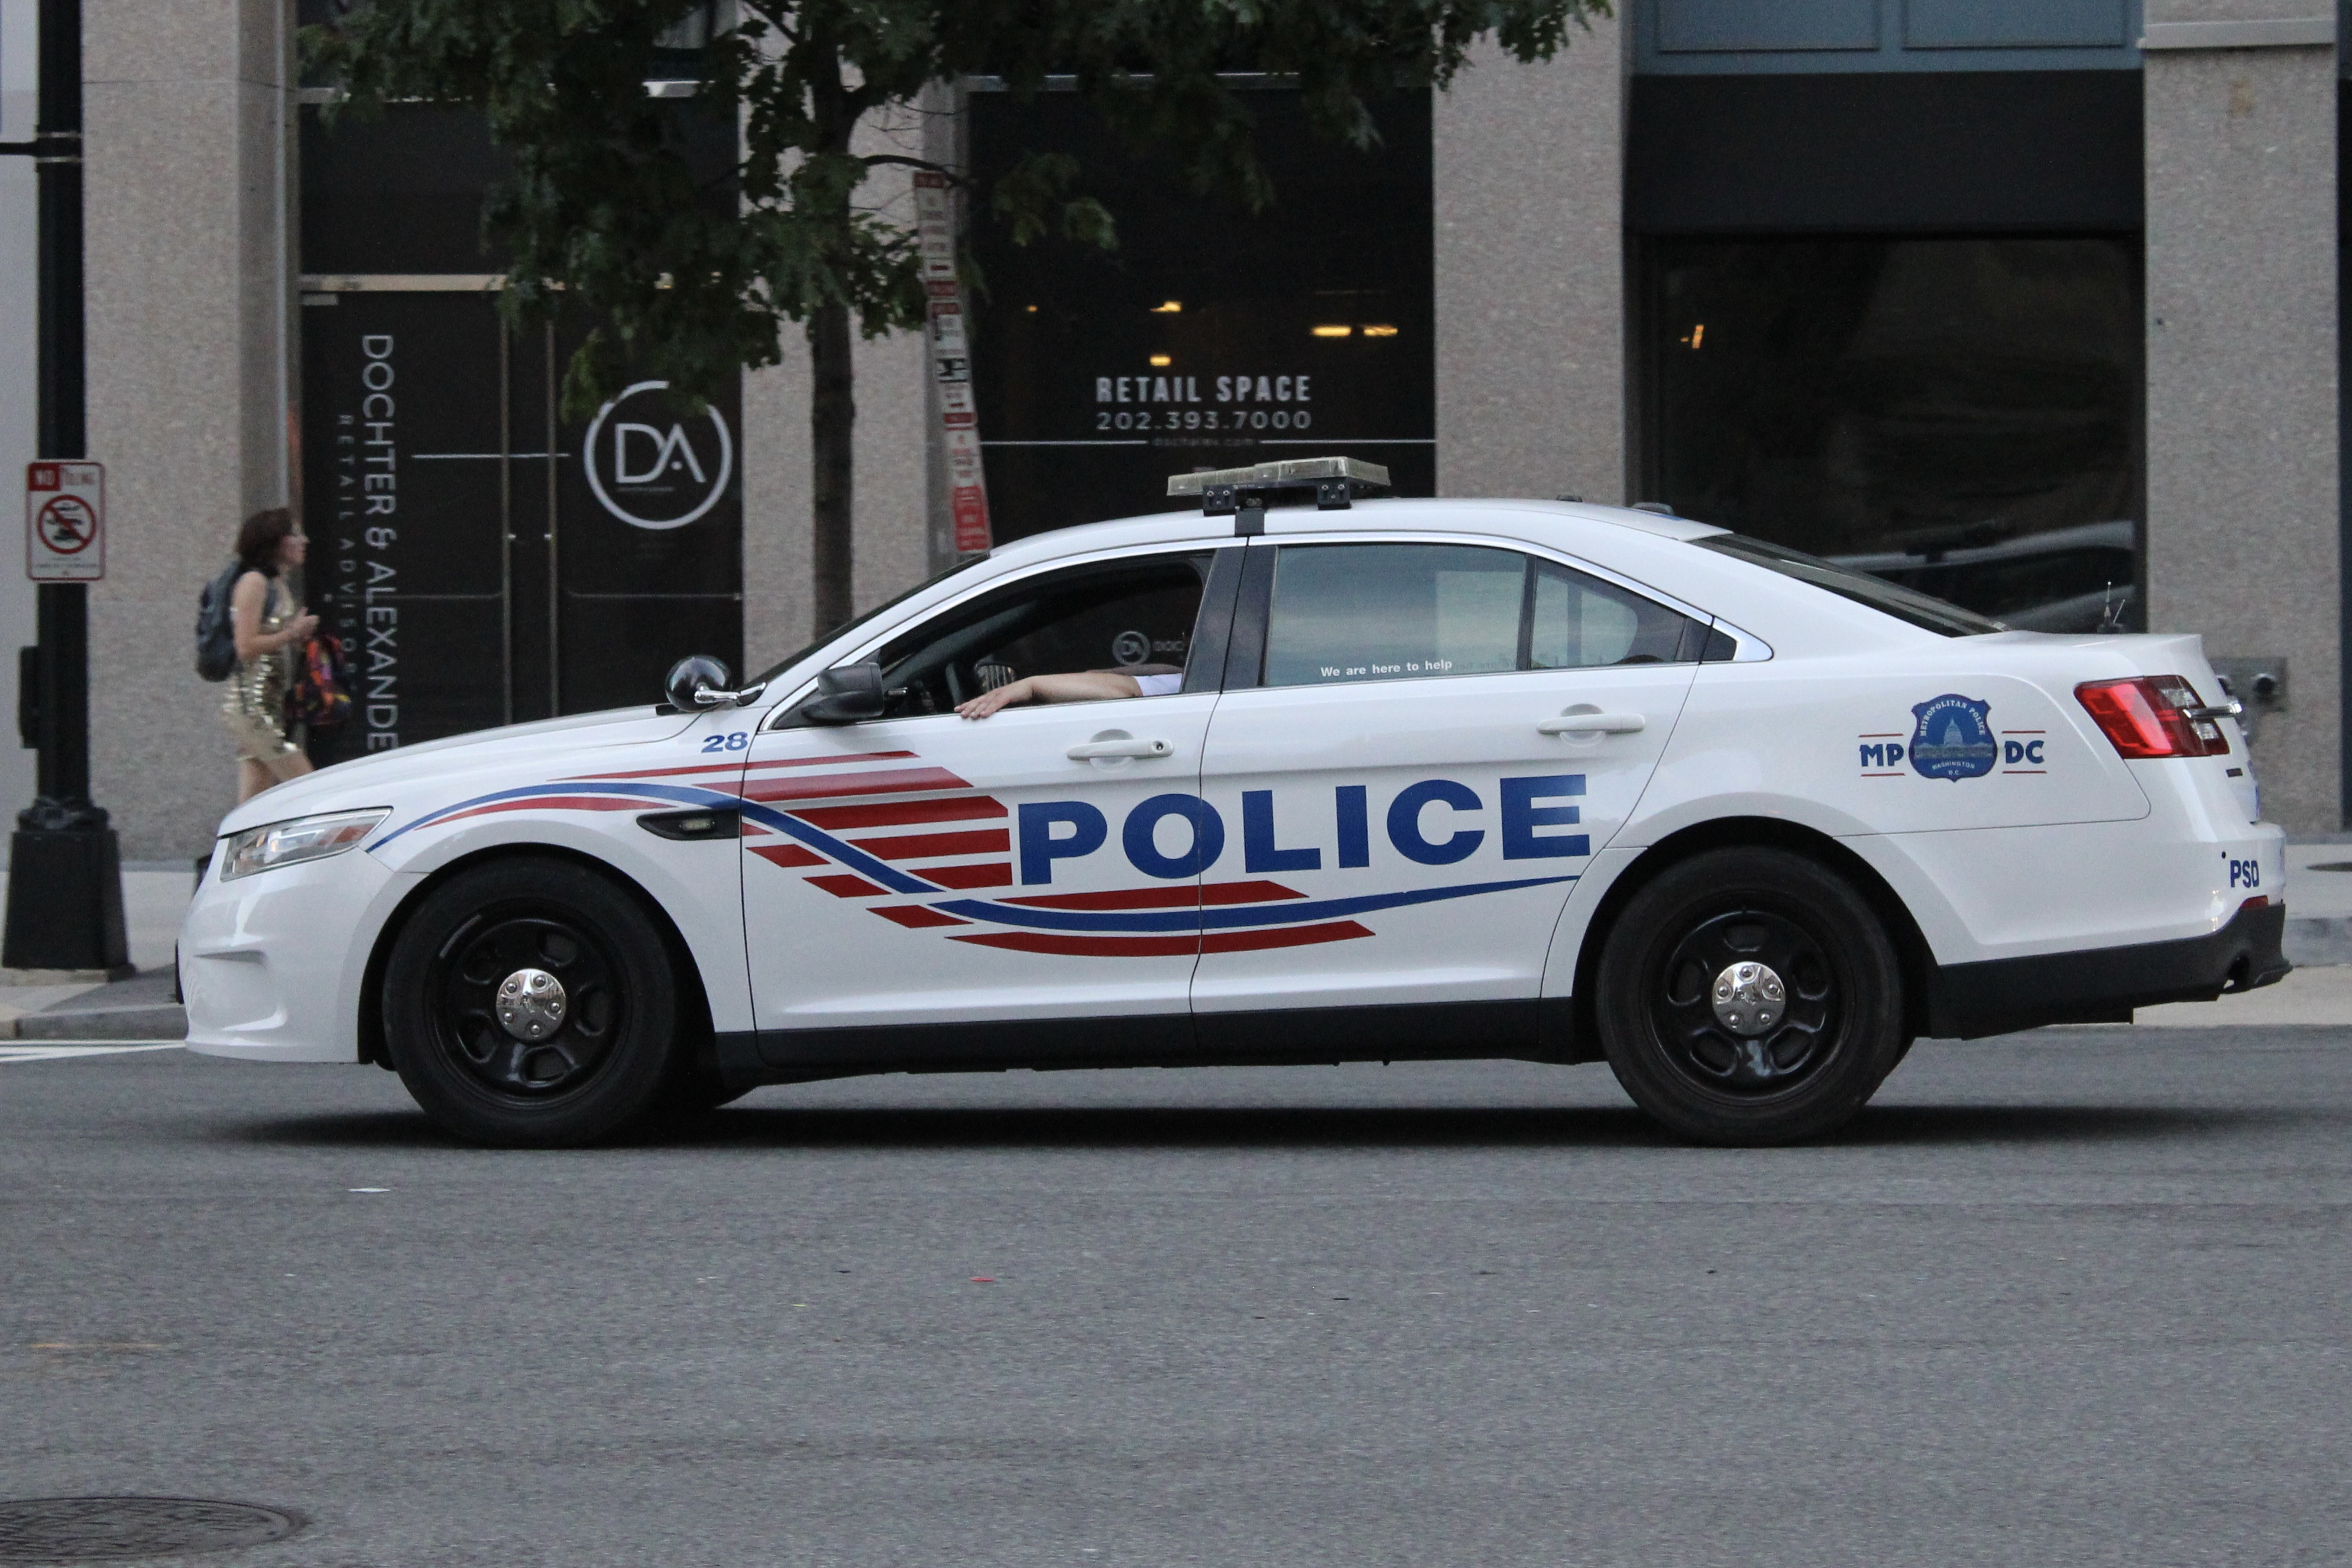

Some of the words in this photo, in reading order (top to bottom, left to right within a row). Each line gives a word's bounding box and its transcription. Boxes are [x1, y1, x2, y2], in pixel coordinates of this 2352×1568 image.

[1096, 376, 1201, 403] RETAIL
[1216, 375, 1311, 402] SPACE
[362, 335, 396, 516] DOCHTER
[1096, 411, 1312, 430] 202.393.7000
[338, 414, 355, 521] RETAIL
[365, 527, 397, 550] &
[365, 562, 399, 750] ALEXANDE
[1320, 666, 1341, 678] We
[1346, 668, 1366, 676] are
[1372, 664, 1401, 675] here
[1407, 662, 1420, 672] to
[1424, 659, 1453, 672] help
[1920, 699, 1968, 737] METROPOLITAN
[1968, 707, 1986, 736] POLICE
[701, 732, 749, 754] 28
[1859, 743, 1904, 767] MP
[2004, 740, 2045, 764] DC
[1932, 761, 1975, 770] WASHINGTON
[1018, 774, 1591, 885] POLICE
[2230, 859, 2260, 889] PSD
